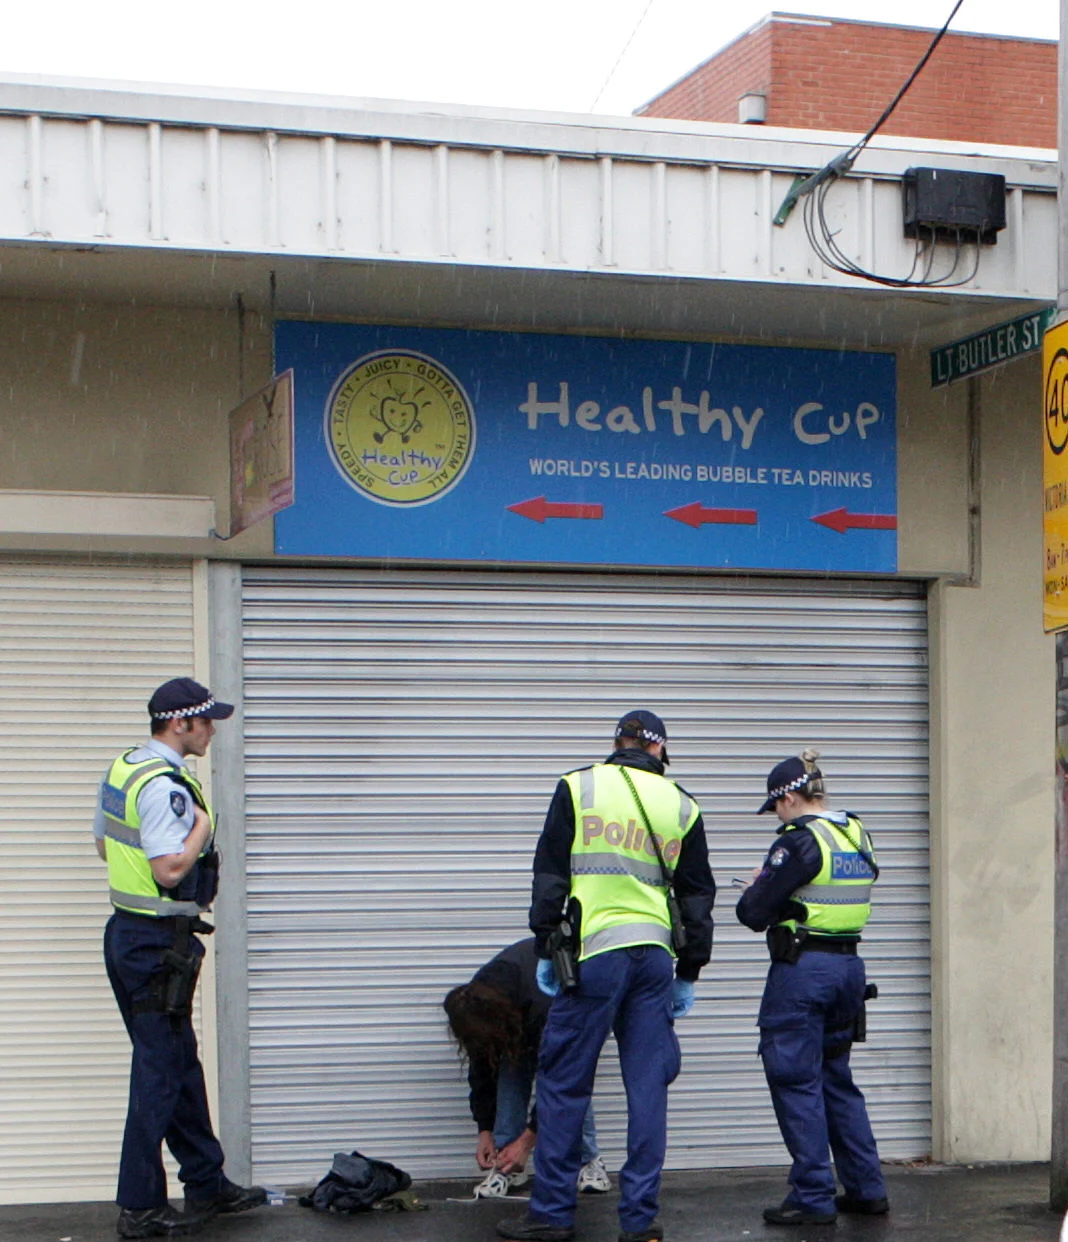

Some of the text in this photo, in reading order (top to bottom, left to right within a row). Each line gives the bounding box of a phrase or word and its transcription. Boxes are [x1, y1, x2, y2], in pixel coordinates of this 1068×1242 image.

[959, 326, 1017, 373] BUTLER
[1022, 317, 1040, 350] ST
[334, 359, 467, 488] SPEEDY TASTY JUICY GOTTA GET THEM ALL
[518, 381, 764, 449] Healthy
[361, 448, 443, 470] Healthy
[528, 458, 873, 488] WORLD'S LEADING BUBBLE TEA DRINKS
[582, 815, 682, 862] Police
